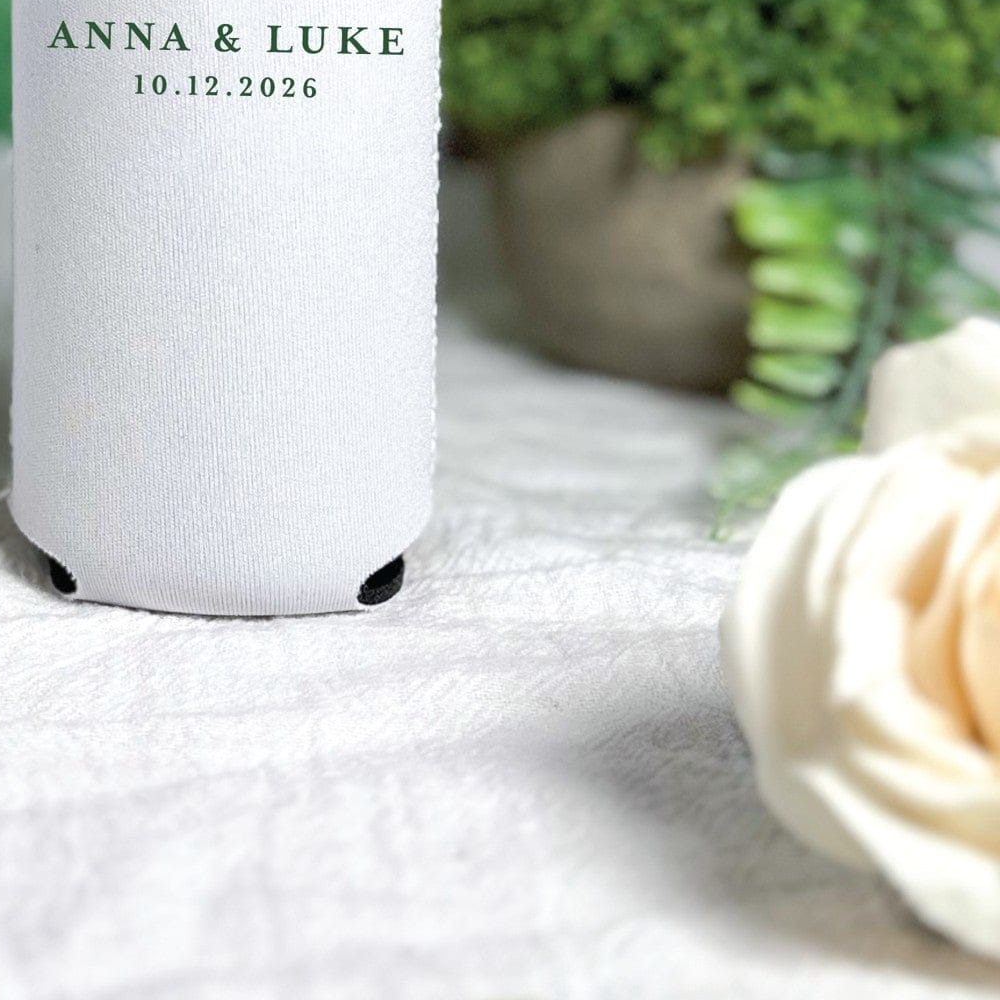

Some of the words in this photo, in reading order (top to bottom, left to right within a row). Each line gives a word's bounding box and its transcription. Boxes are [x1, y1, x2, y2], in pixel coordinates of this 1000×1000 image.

[47, 20, 191, 51] ANNA
[213, 23, 242, 53] &
[266, 24, 405, 56] LUKE
[134, 74, 318, 99] 10.12.2026
